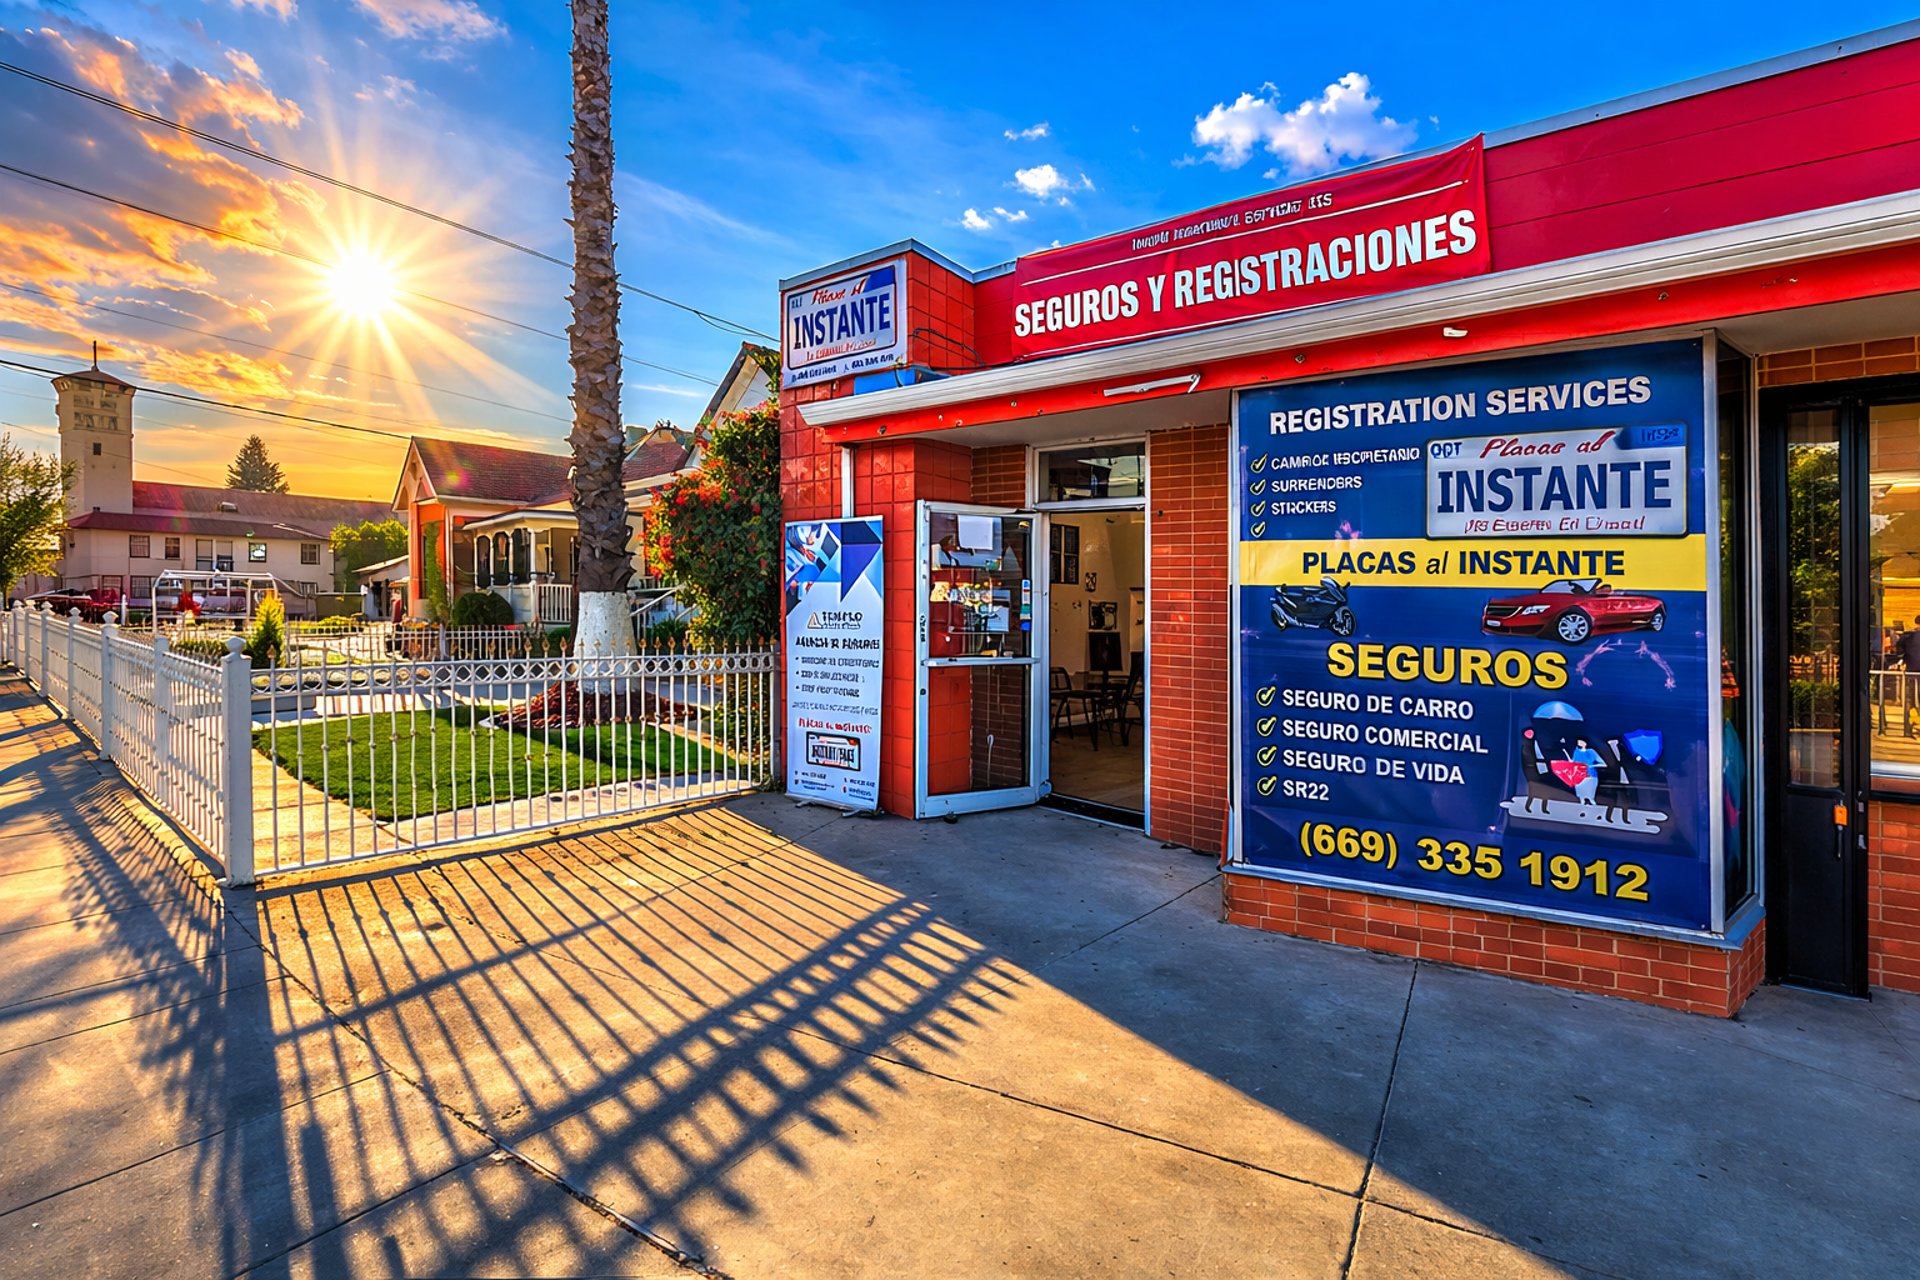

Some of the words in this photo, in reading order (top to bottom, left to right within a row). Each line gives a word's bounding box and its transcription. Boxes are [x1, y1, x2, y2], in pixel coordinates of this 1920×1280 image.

[1014, 280, 1139, 337] SEGUROS
[1147, 274, 1166, 312] Y
[1174, 209, 1477, 309] REGISTRACIONES
[793, 293, 890, 349] INSTANTE
[1270, 392, 1476, 435] REGISTRATION
[1486, 375, 1651, 416] SERVICES
[1437, 459, 1672, 513] INSTANTE
[1302, 550, 1416, 575] PLACAS
[1426, 550, 1448, 575] al
[1459, 550, 1626, 577] INSTANTE
[1327, 642, 1569, 689] SEGUROS
[1282, 689, 1360, 711] SEGURO
[1367, 695, 1393, 714] DE
[1400, 697, 1474, 720] CARRO
[1282, 719, 1359, 743] SEGURO
[1365, 727, 1489, 754] COMERCIAL
[1282, 749, 1366, 774] SEGURO
[1375, 757, 1405, 778] DE
[1412, 762, 1465, 785] VIDA
[1283, 779, 1330, 801] SR22
[1300, 821, 1398, 870] (669)
[1416, 838, 1503, 879] 335
[1518, 851, 1650, 901] 1912
